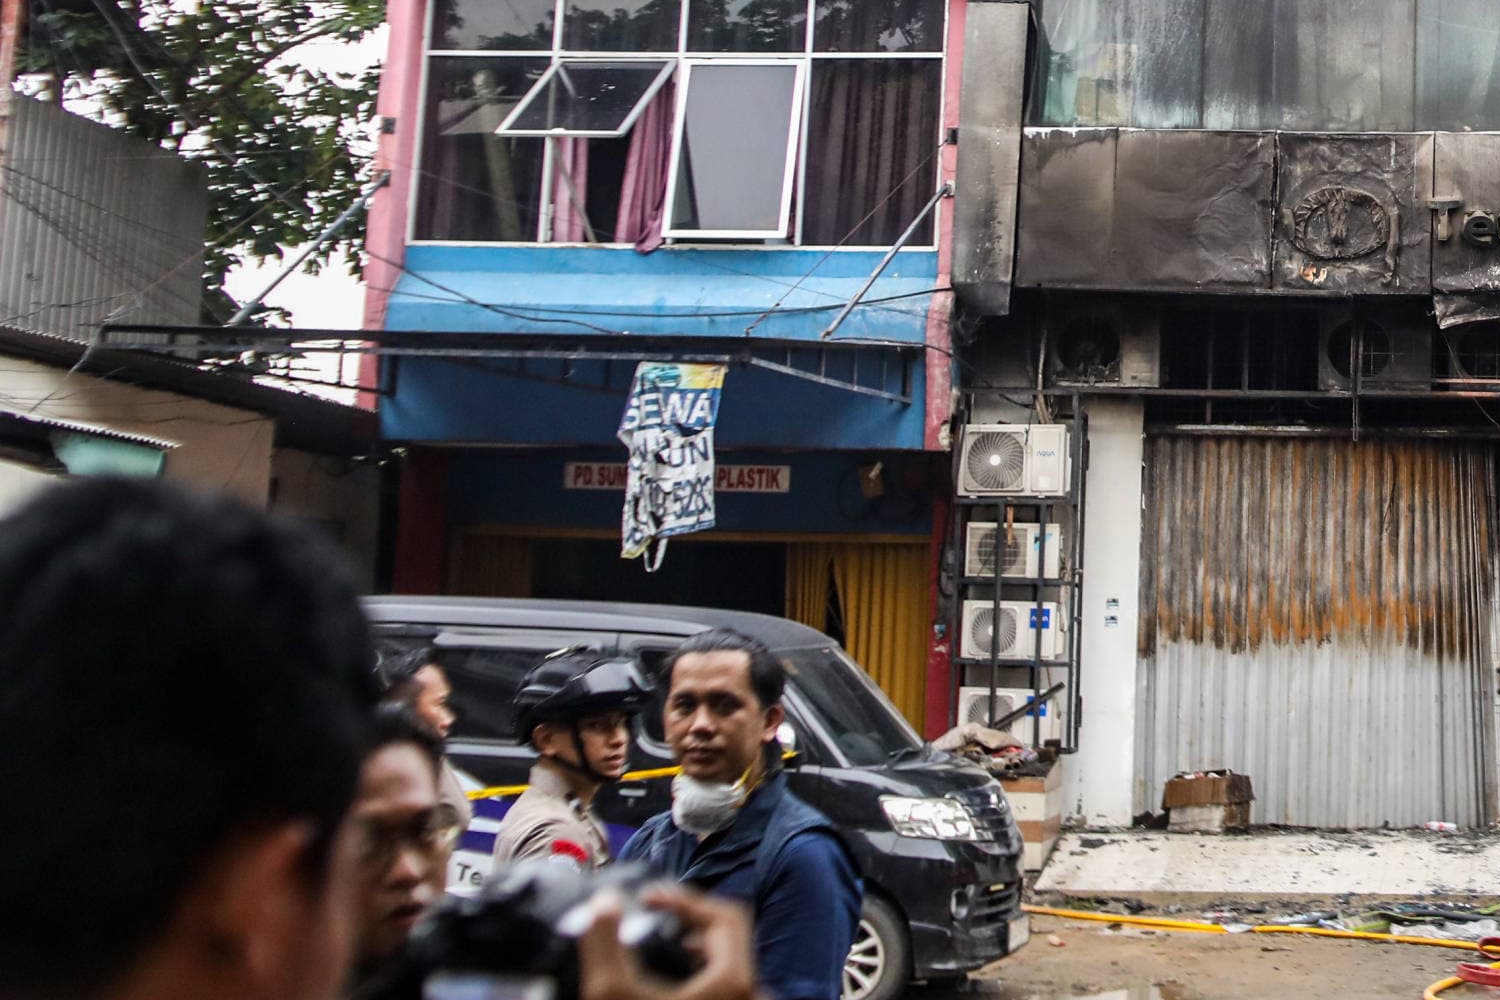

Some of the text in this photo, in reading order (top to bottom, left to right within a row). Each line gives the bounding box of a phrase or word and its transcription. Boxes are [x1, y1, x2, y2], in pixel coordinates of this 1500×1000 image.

[624, 392, 713, 426] SEWA
[599, 466, 627, 487] SUM
[717, 468, 781, 489] PLASTIK
[456, 862, 483, 886] Te
